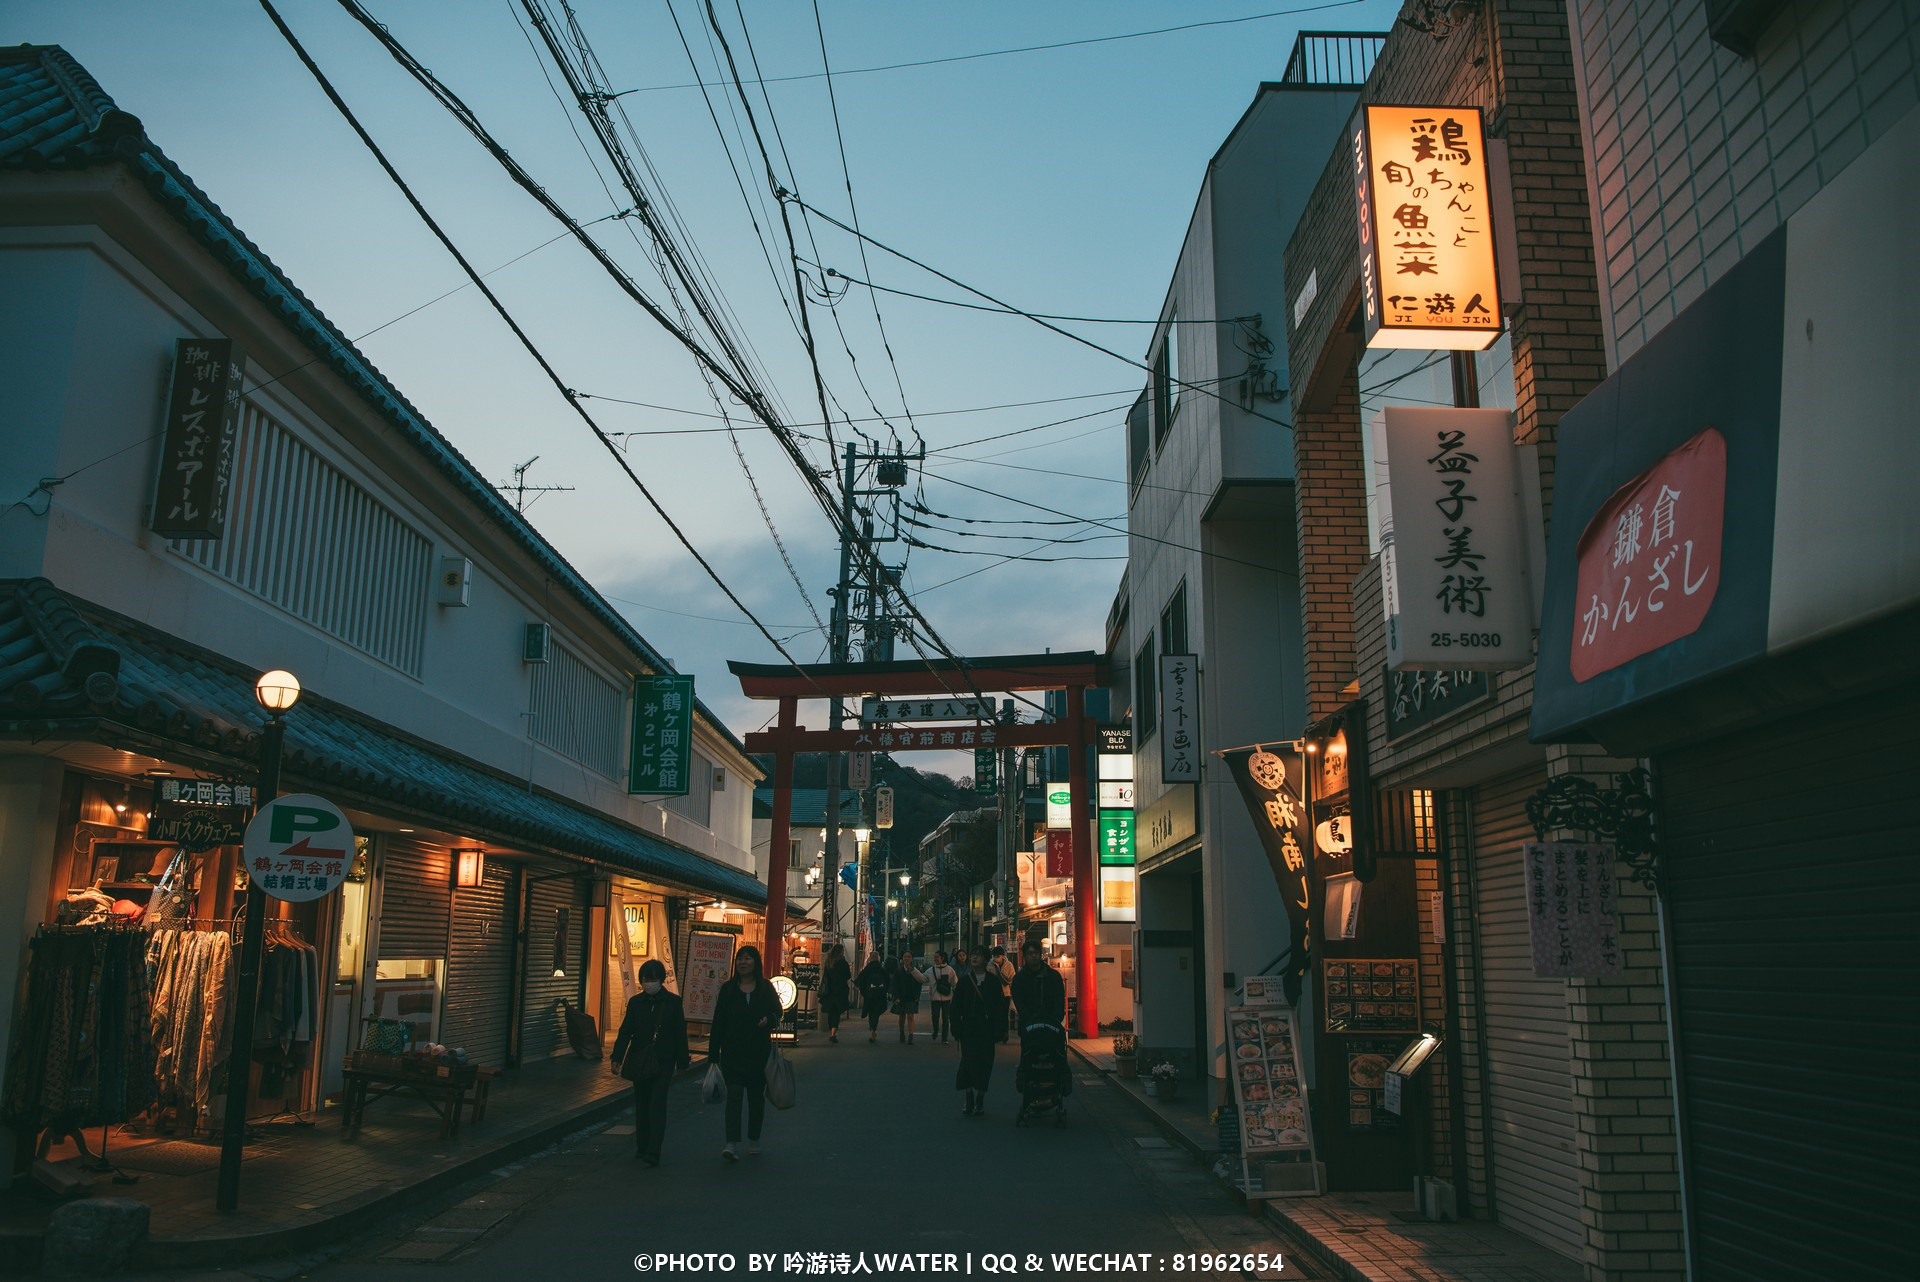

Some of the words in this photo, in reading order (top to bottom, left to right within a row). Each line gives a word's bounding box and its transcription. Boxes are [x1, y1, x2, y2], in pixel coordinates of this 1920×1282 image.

[1381, 160, 1438, 276] 旬の魚菜
[1426, 316, 1453, 324] YOU
[1462, 316, 1491, 324] JIN
[1427, 430, 1492, 617] 益子美術
[1613, 485, 1681, 569] 鎌倉
[1581, 540, 1709, 647] かんざし
[1431, 633, 1501, 647] 25-5030
[854, 729, 997, 746] 八幡宮前商店会
[269, 804, 340, 844] P
[263, 874, 328, 891] 結婚式場
[1555, 850, 1572, 966] まとめることが
[1575, 850, 1590, 914] 髪を上に
[624, 907, 645, 923] ODA
